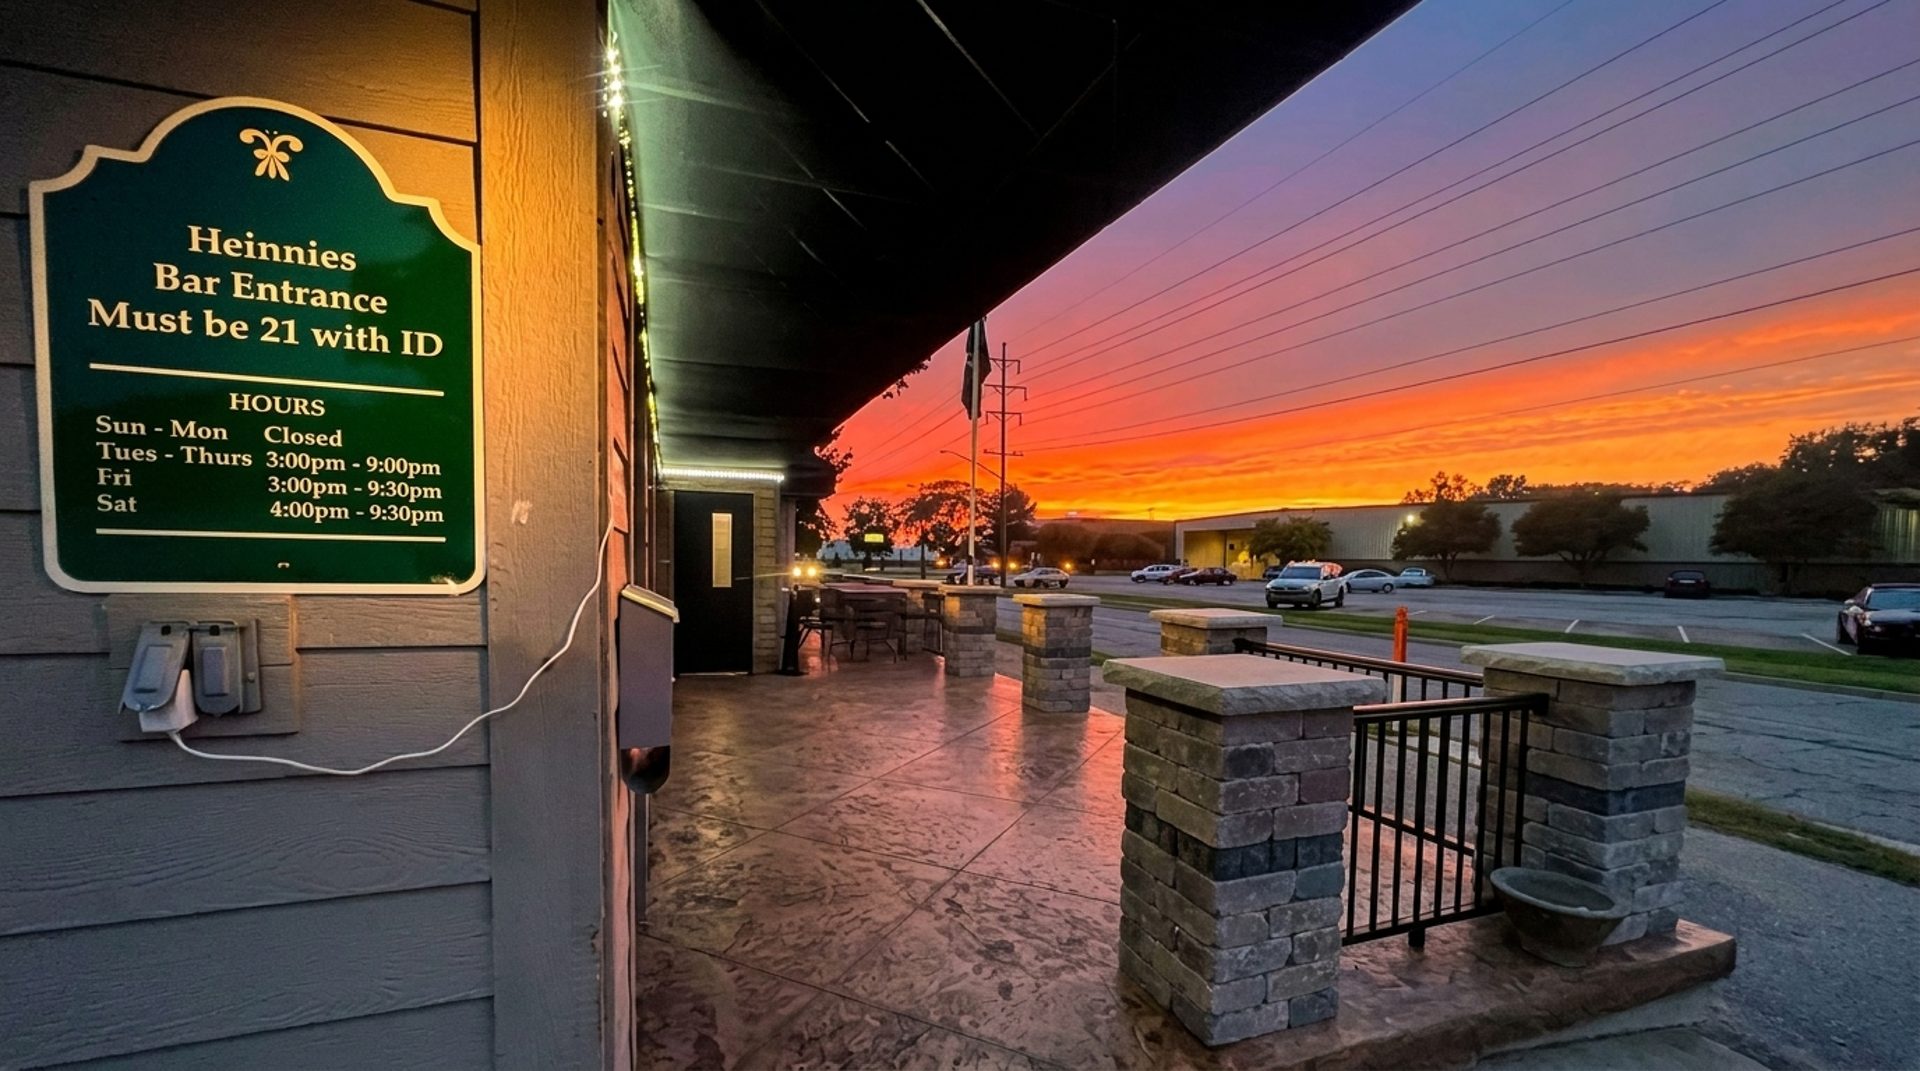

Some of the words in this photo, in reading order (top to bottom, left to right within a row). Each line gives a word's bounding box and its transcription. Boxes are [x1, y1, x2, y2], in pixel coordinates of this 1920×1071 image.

[187, 225, 357, 272] Heinnies
[153, 262, 221, 296] Bar
[231, 271, 388, 315] Entrance
[87, 298, 193, 335] Must
[203, 309, 249, 340] be
[260, 316, 300, 345] 21
[310, 327, 391, 354] with
[401, 330, 443, 357] ID
[229, 392, 326, 417] HOURS
[96, 415, 146, 435] Sun
[170, 419, 229, 440] Mon
[263, 425, 343, 448] Closed
[96, 441, 158, 462] Tues
[179, 445, 253, 467] Thurs
[266, 450, 346, 473] 3:00pm
[366, 455, 441, 479] 9:00pm
[97, 467, 132, 486] Fri
[268, 475, 348, 499] 3:00pm
[367, 480, 443, 503] 9:30pm
[96, 494, 138, 512] Sat
[269, 500, 350, 523] 4:00pm
[369, 504, 445, 526] 9:30pm
